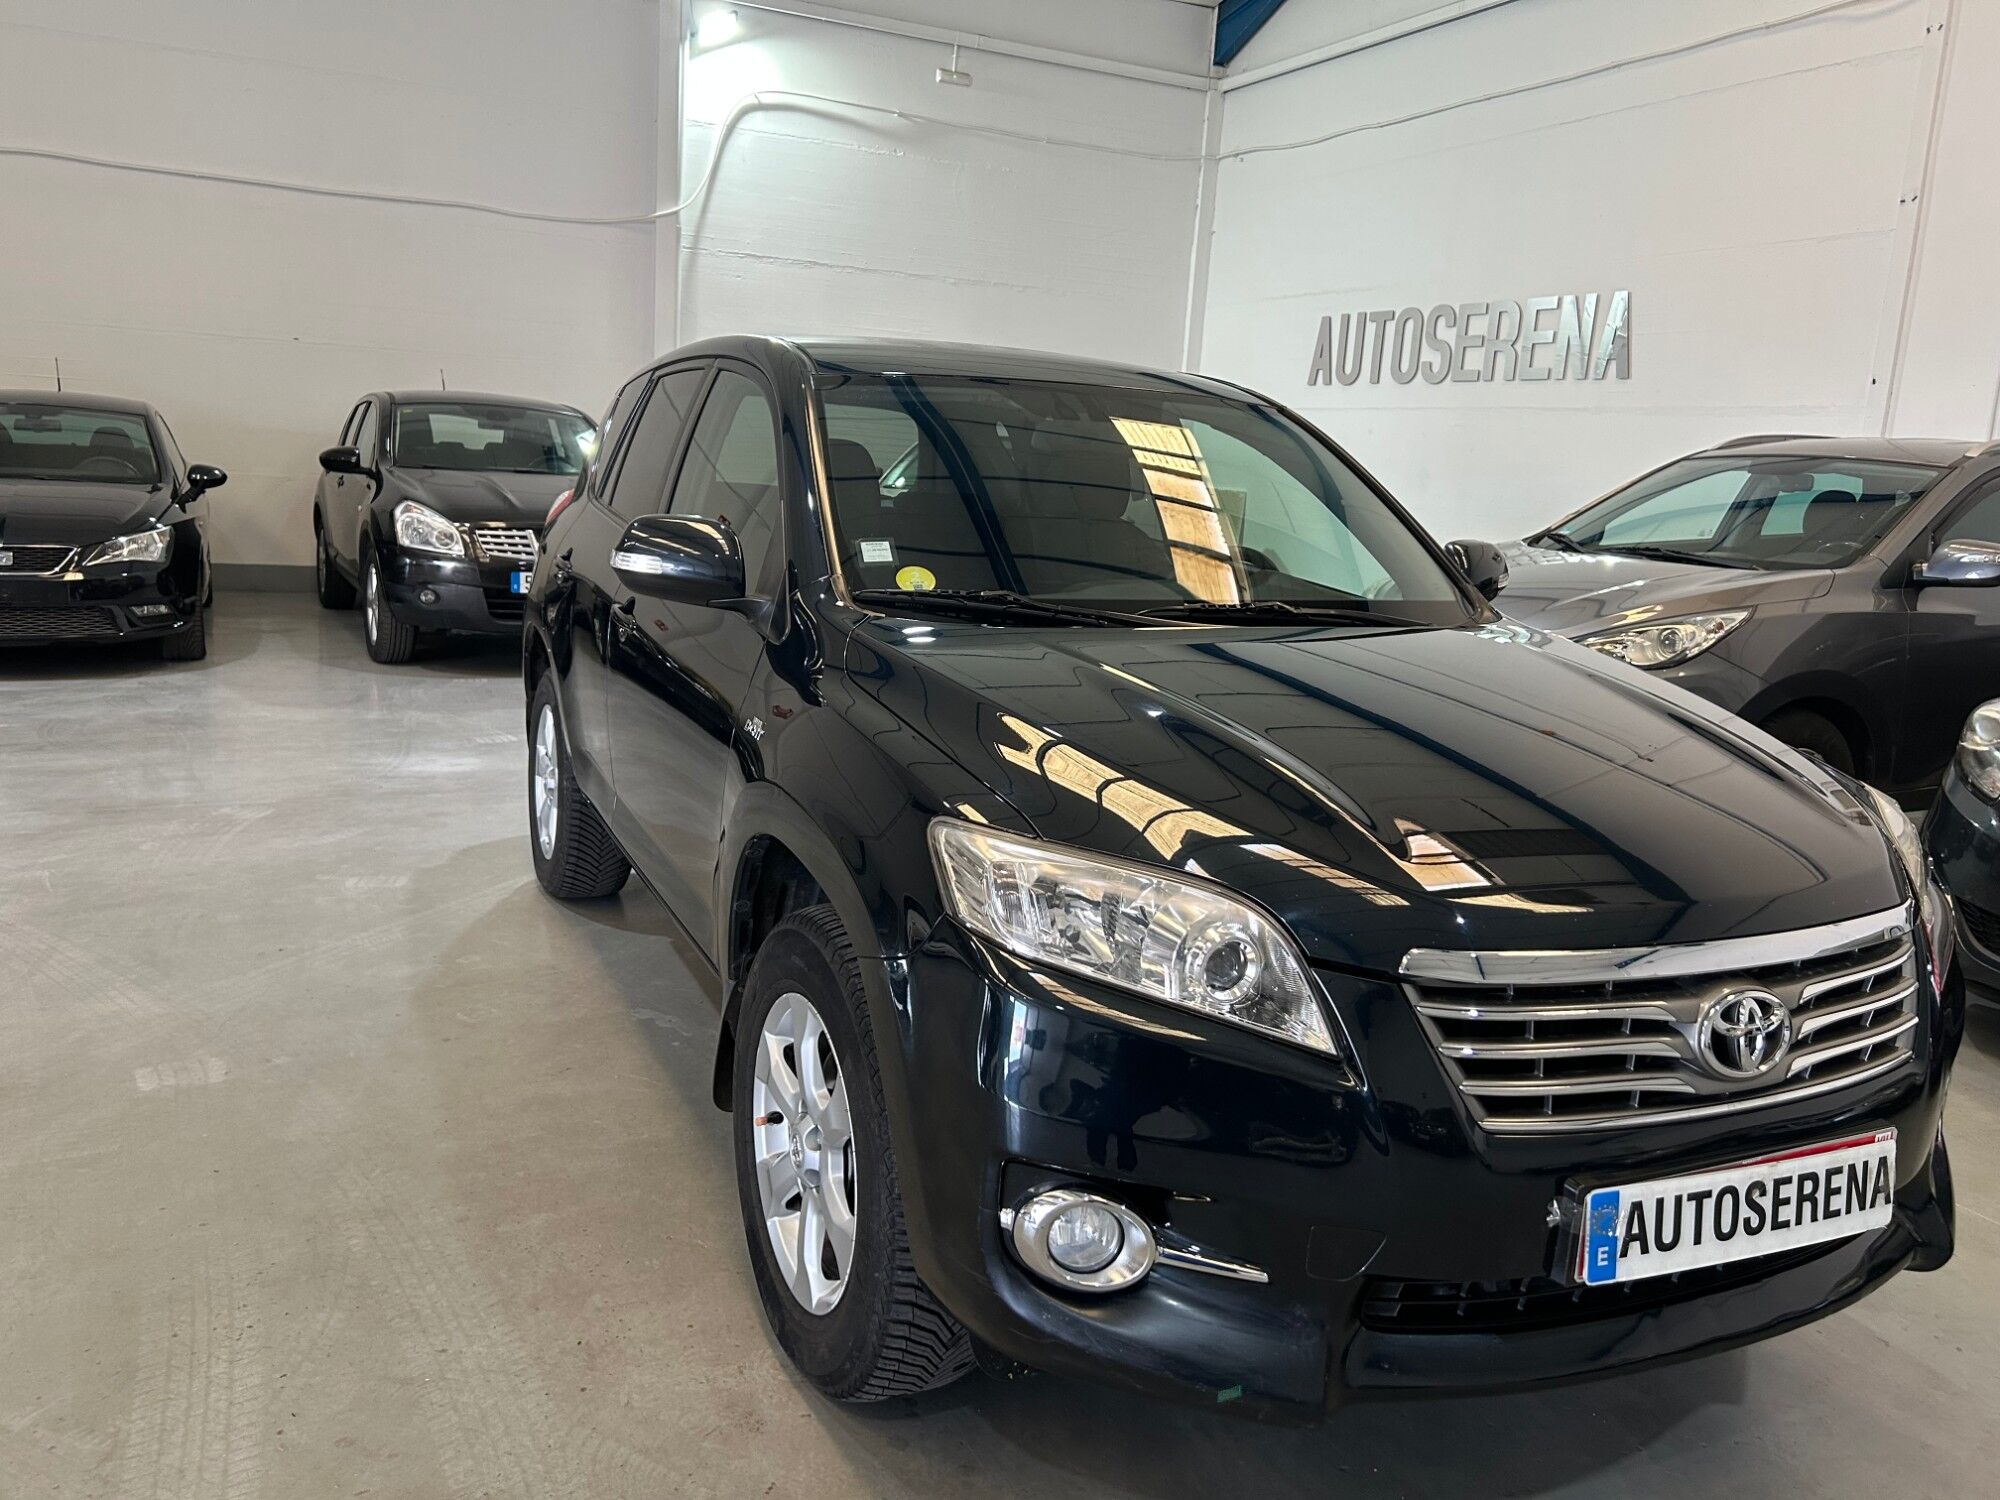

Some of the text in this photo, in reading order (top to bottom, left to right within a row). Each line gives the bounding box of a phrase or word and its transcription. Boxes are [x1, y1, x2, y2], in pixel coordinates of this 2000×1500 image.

[1307, 290, 1629, 386] AUTOSERENA
[1597, 1155, 1892, 1267] E AUTOSERENA
